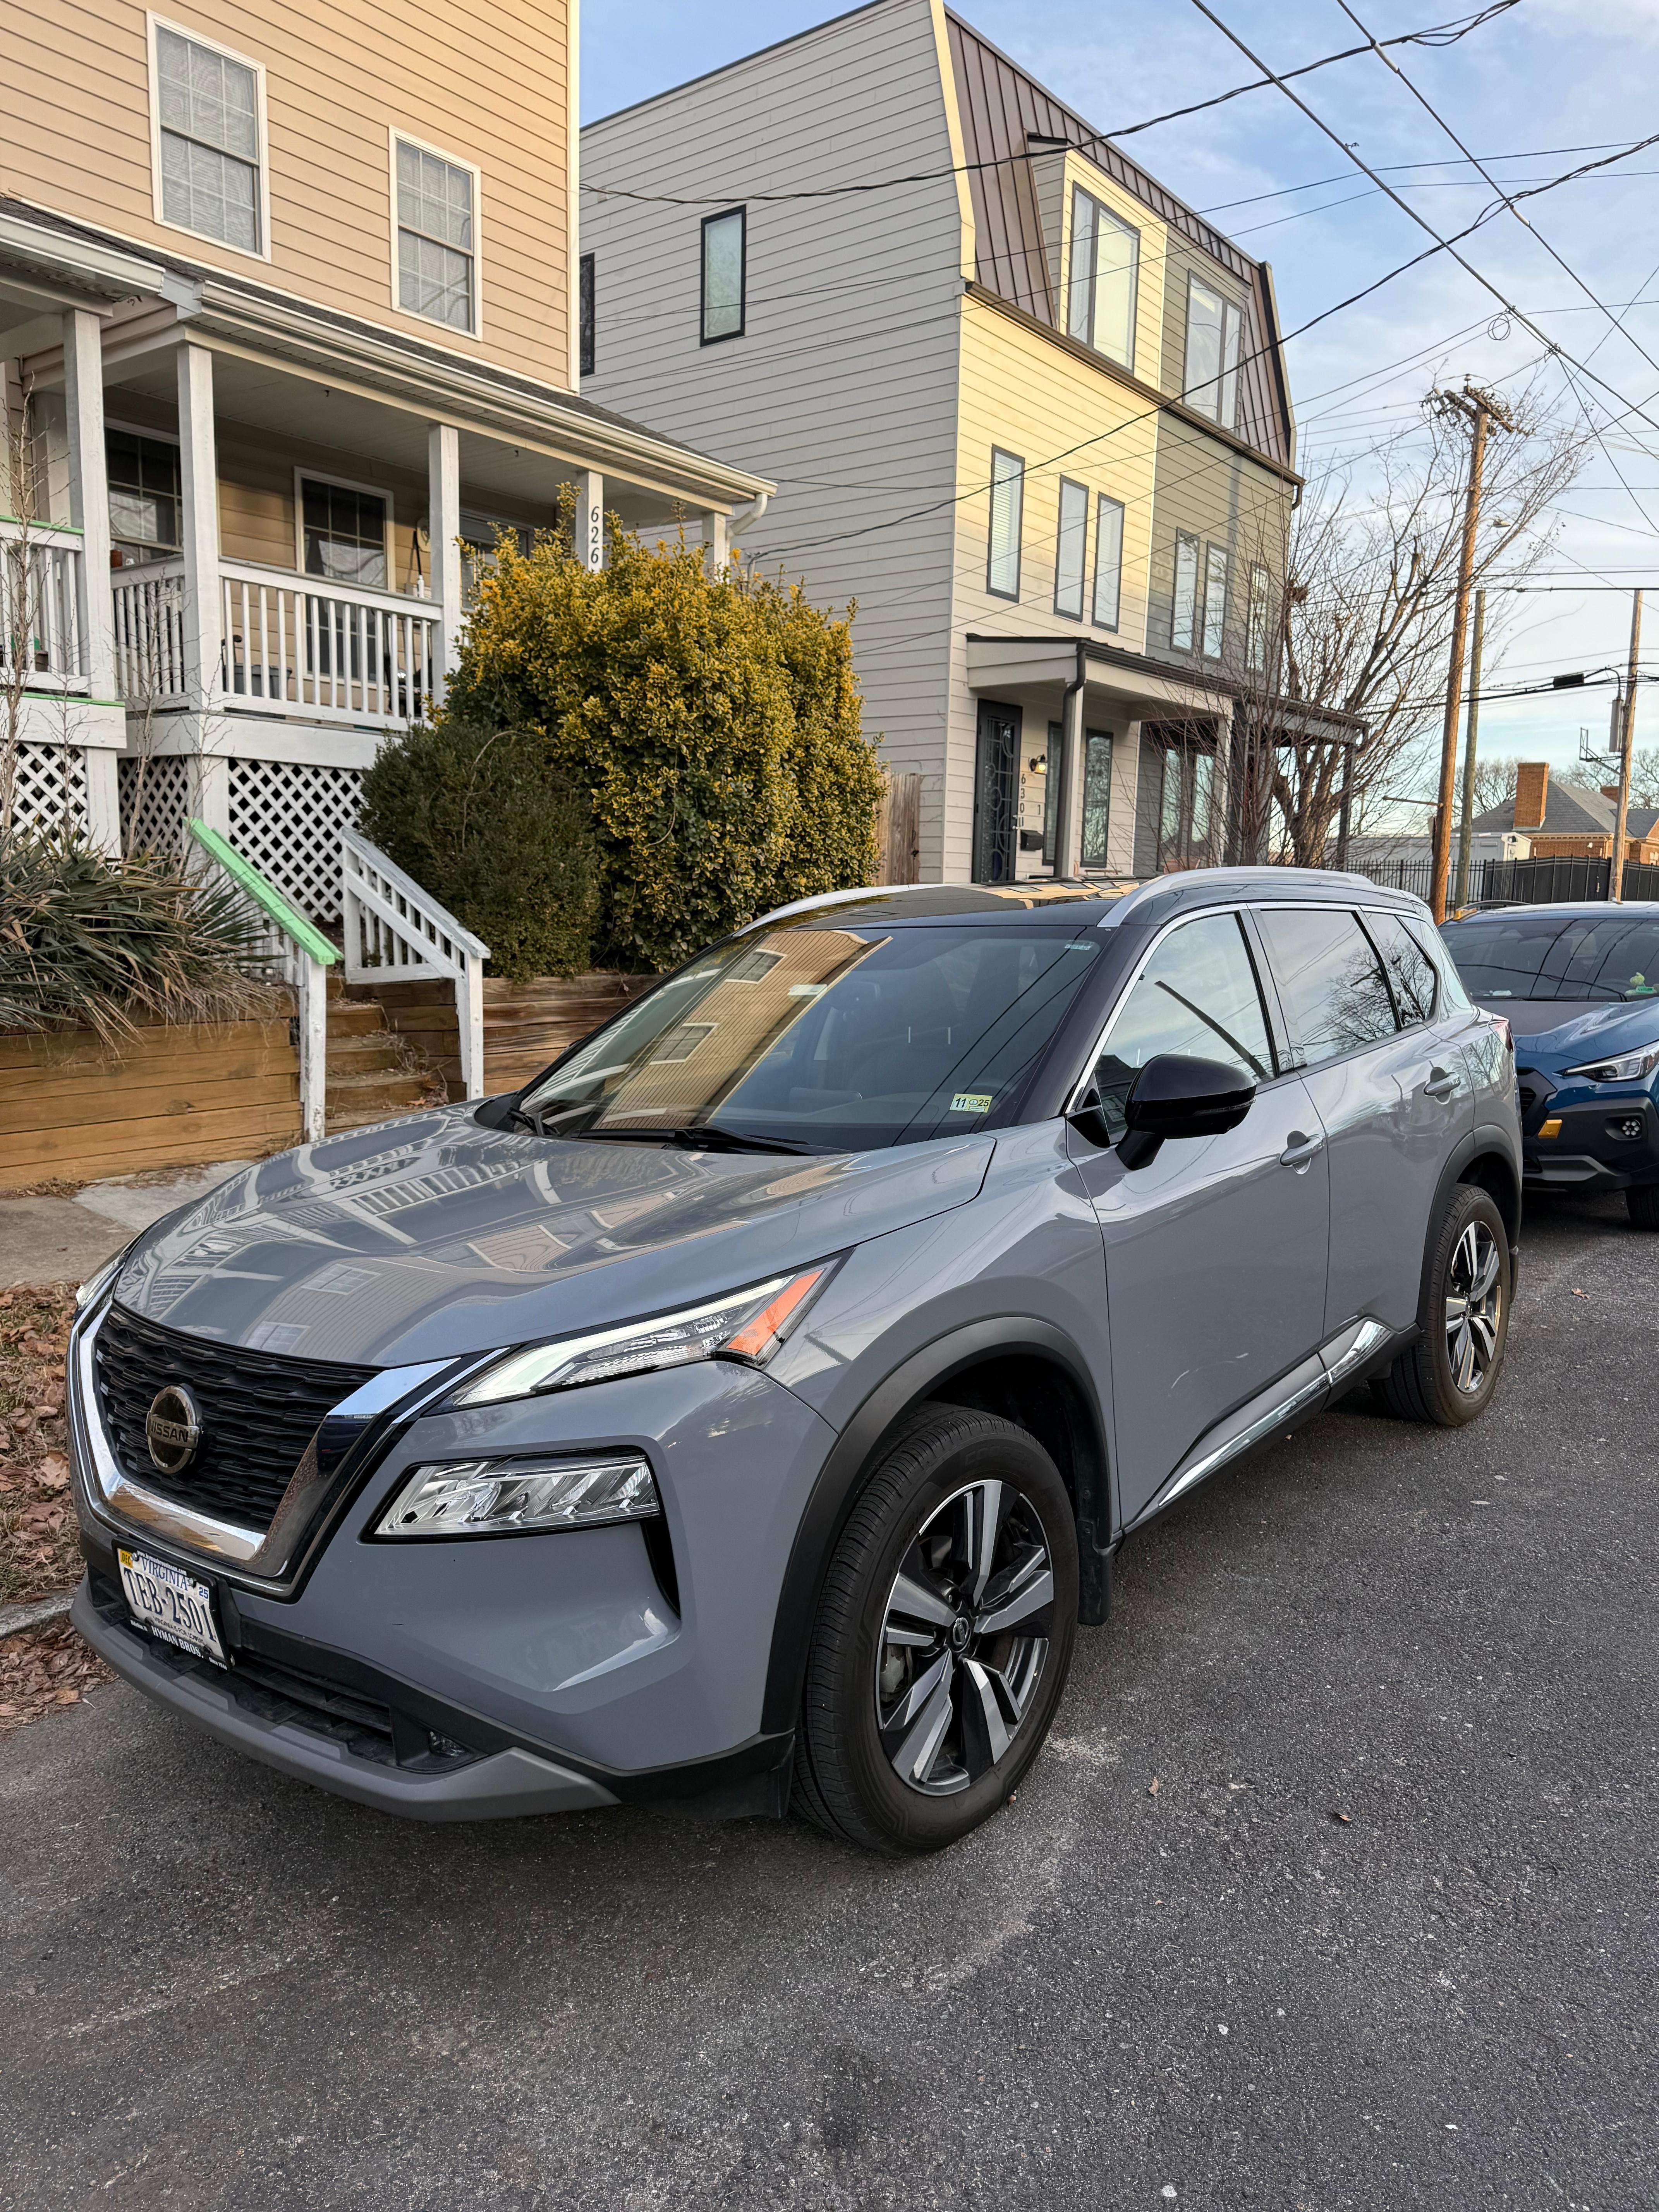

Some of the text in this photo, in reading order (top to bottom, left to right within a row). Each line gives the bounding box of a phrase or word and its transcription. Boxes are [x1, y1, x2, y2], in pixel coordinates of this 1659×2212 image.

[591, 506, 600, 564] 626
[955, 1097, 967, 1108] 11
[150, 1420, 189, 1443] NISSAN
[122, 1553, 131, 1565] DEC
[142, 1557, 188, 1591] VIRGINIA
[199, 1587, 208, 1599] 25
[151, 1625, 179, 1647] HYMAN
[178, 1638, 204, 1659] BROS.
